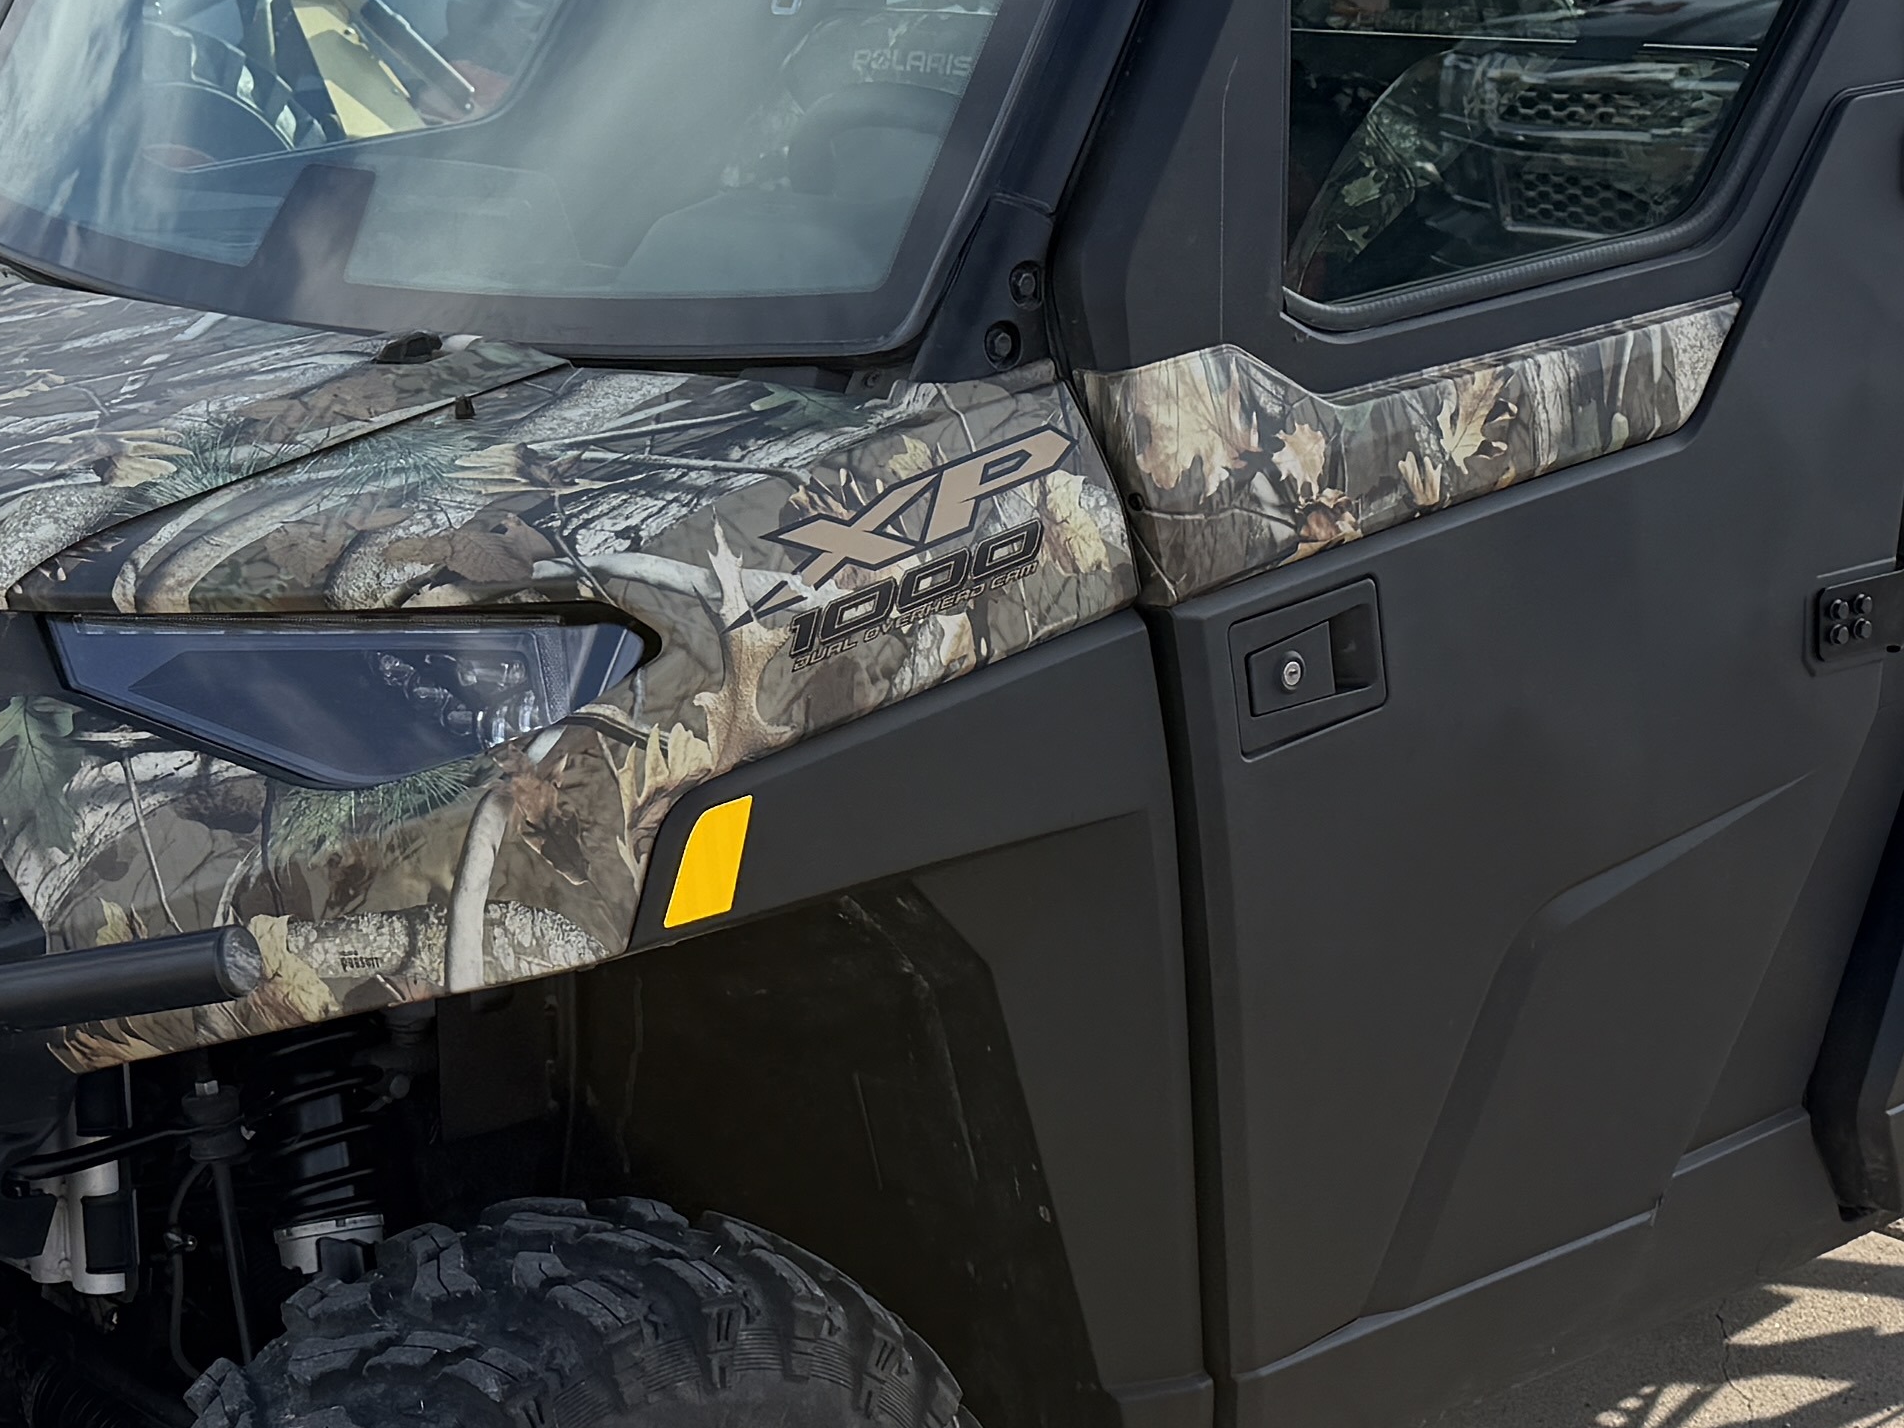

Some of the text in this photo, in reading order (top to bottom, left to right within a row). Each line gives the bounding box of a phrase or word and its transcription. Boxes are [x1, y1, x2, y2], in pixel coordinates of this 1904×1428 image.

[852, 48, 973, 77] POLARIS
[720, 425, 1078, 633] XP
[789, 518, 1044, 657] 1000
[792, 560, 1039, 673] DUAL OVERHEAD CAM
